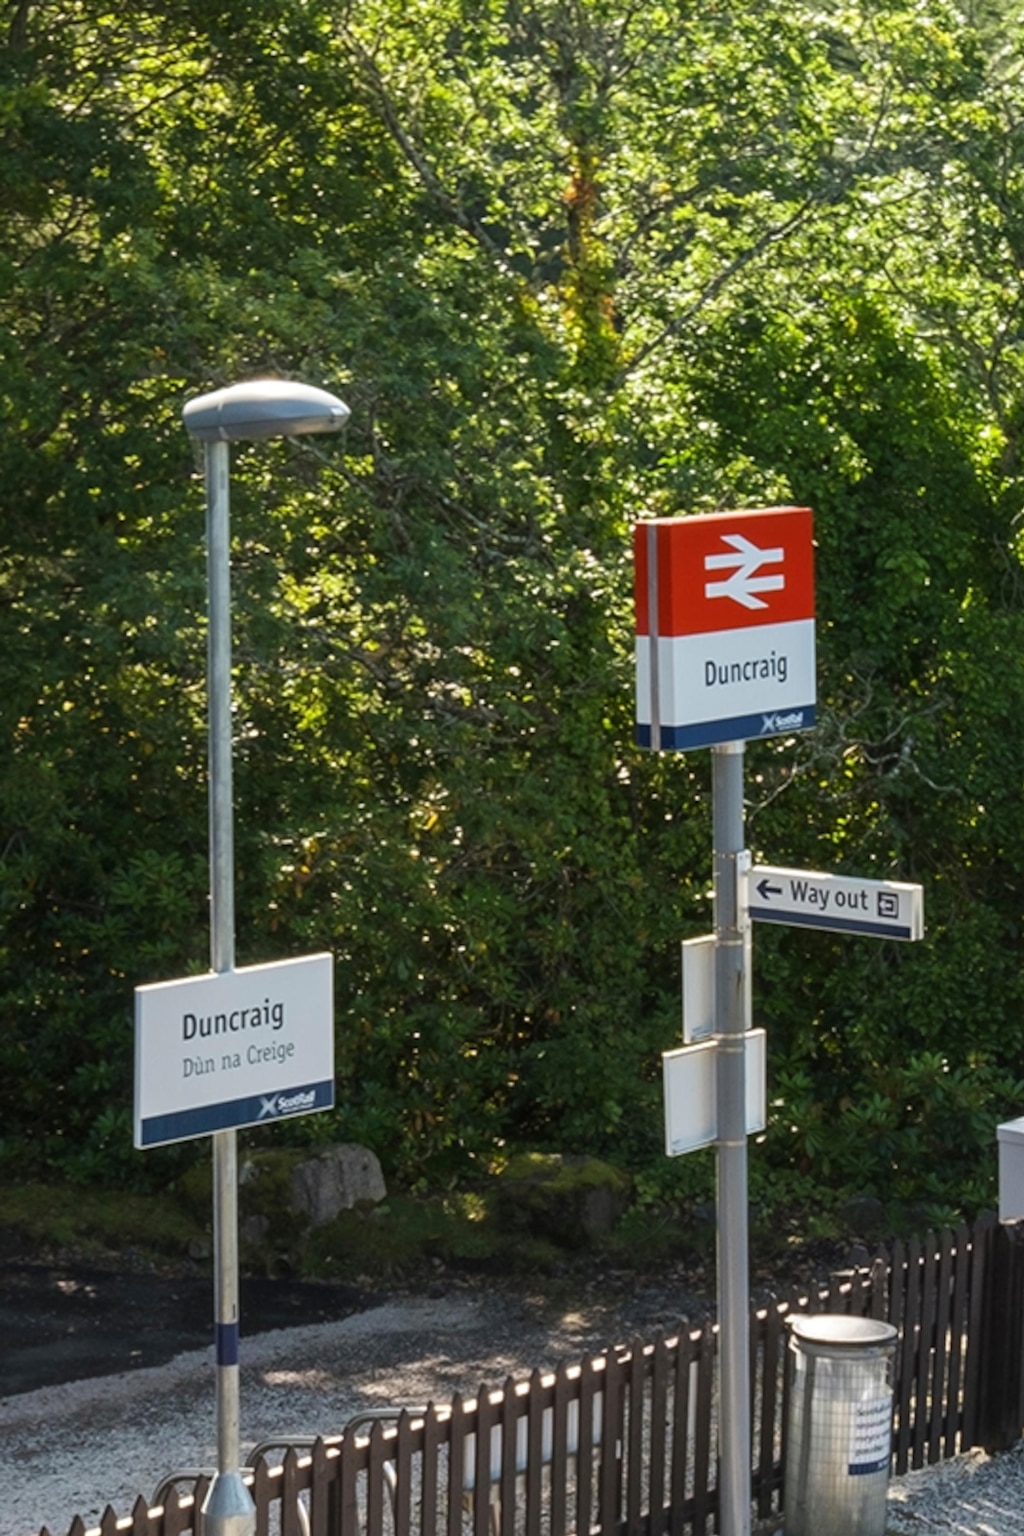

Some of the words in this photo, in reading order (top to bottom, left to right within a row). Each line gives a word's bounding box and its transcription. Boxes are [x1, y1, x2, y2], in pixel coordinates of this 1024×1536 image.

[704, 651, 788, 687] Duncraig
[790, 878, 830, 911] Way
[834, 888, 869, 911] out
[183, 998, 284, 1041] Duncraig
[183, 1056, 215, 1078] Dùn
[221, 1053, 241, 1071] na
[246, 1040, 295, 1066] Creige
[277, 1090, 316, 1111] ScotRail
